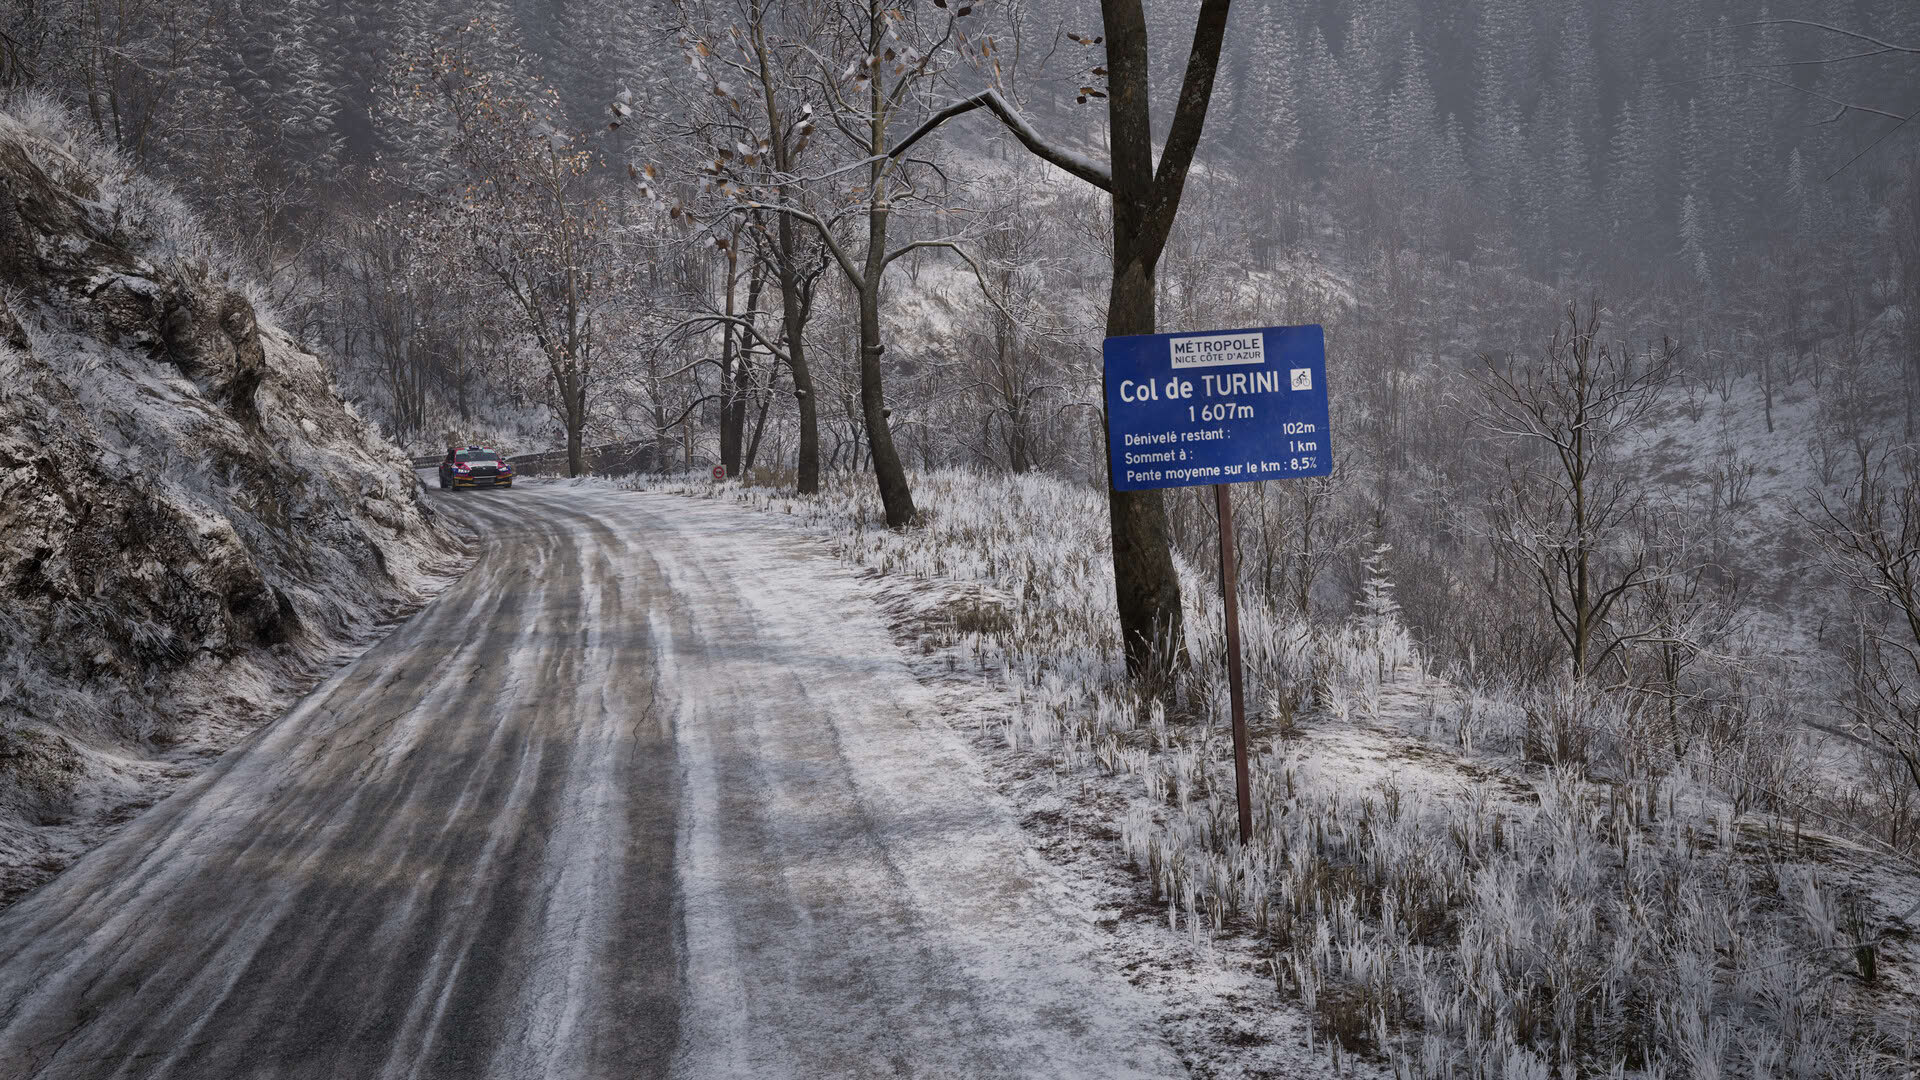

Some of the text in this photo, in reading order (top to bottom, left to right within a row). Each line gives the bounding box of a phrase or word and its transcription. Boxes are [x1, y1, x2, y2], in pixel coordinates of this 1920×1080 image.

[1175, 338, 1260, 353] MÉTROPOLE
[1175, 351, 1261, 363] NICE CÔTE D'AZUR
[1120, 371, 1279, 402] Col de TURINI
[1283, 423, 1315, 434] 102m
[1125, 432, 1177, 445] Dénivelé
[1181, 429, 1223, 442] restant
[1125, 452, 1176, 465] Sommet
[1180, 449, 1187, 460] à
[1127, 469, 1161, 483] Pente
[1166, 465, 1220, 482] moyenne
[1224, 463, 1243, 475] sur
[1247, 462, 1257, 473] le
[1261, 461, 1281, 473] km
[1291, 457, 1317, 471] 8,5%
